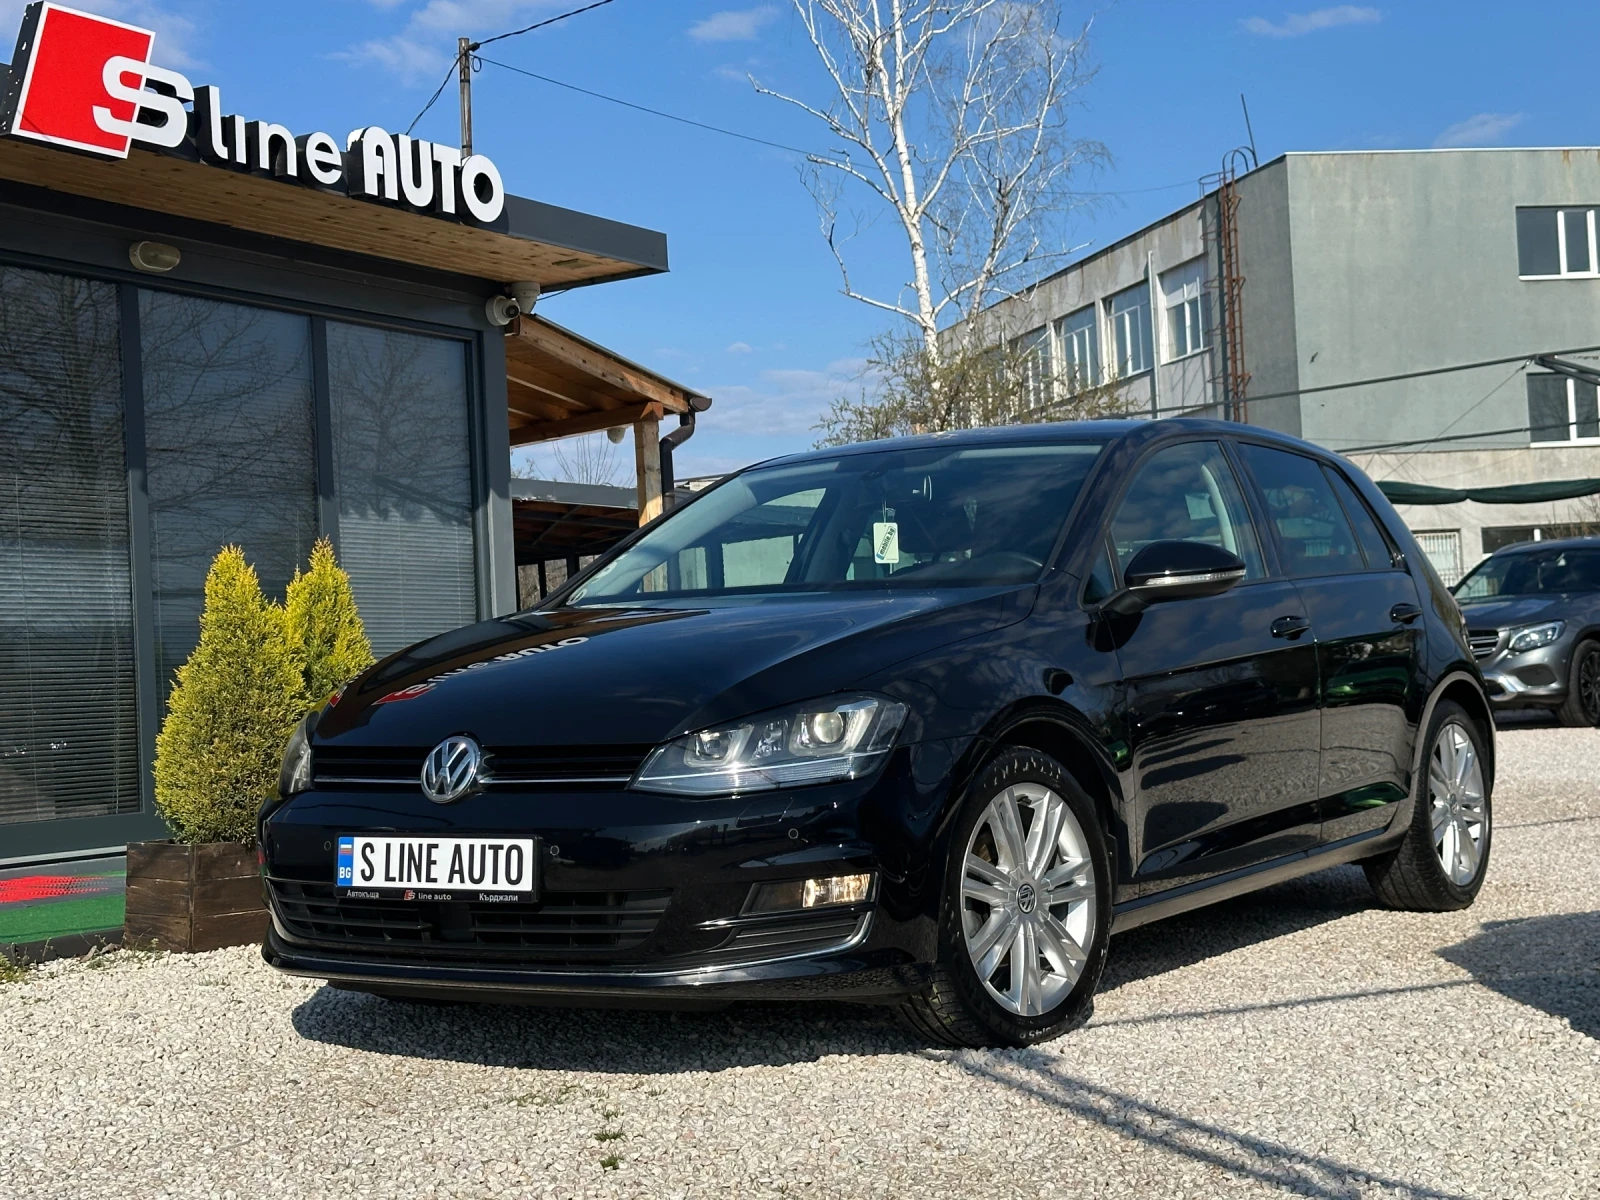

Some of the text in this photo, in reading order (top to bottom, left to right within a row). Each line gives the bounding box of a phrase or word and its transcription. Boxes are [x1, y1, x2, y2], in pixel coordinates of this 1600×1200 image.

[92, 56, 505, 223] S line AUTO
[360, 842, 524, 885] S LINE AUTO
[339, 866, 351, 878] BG
[346, 889, 380, 899] Автокъща
[418, 892, 432, 900] line
[479, 892, 518, 902] Кърджали
